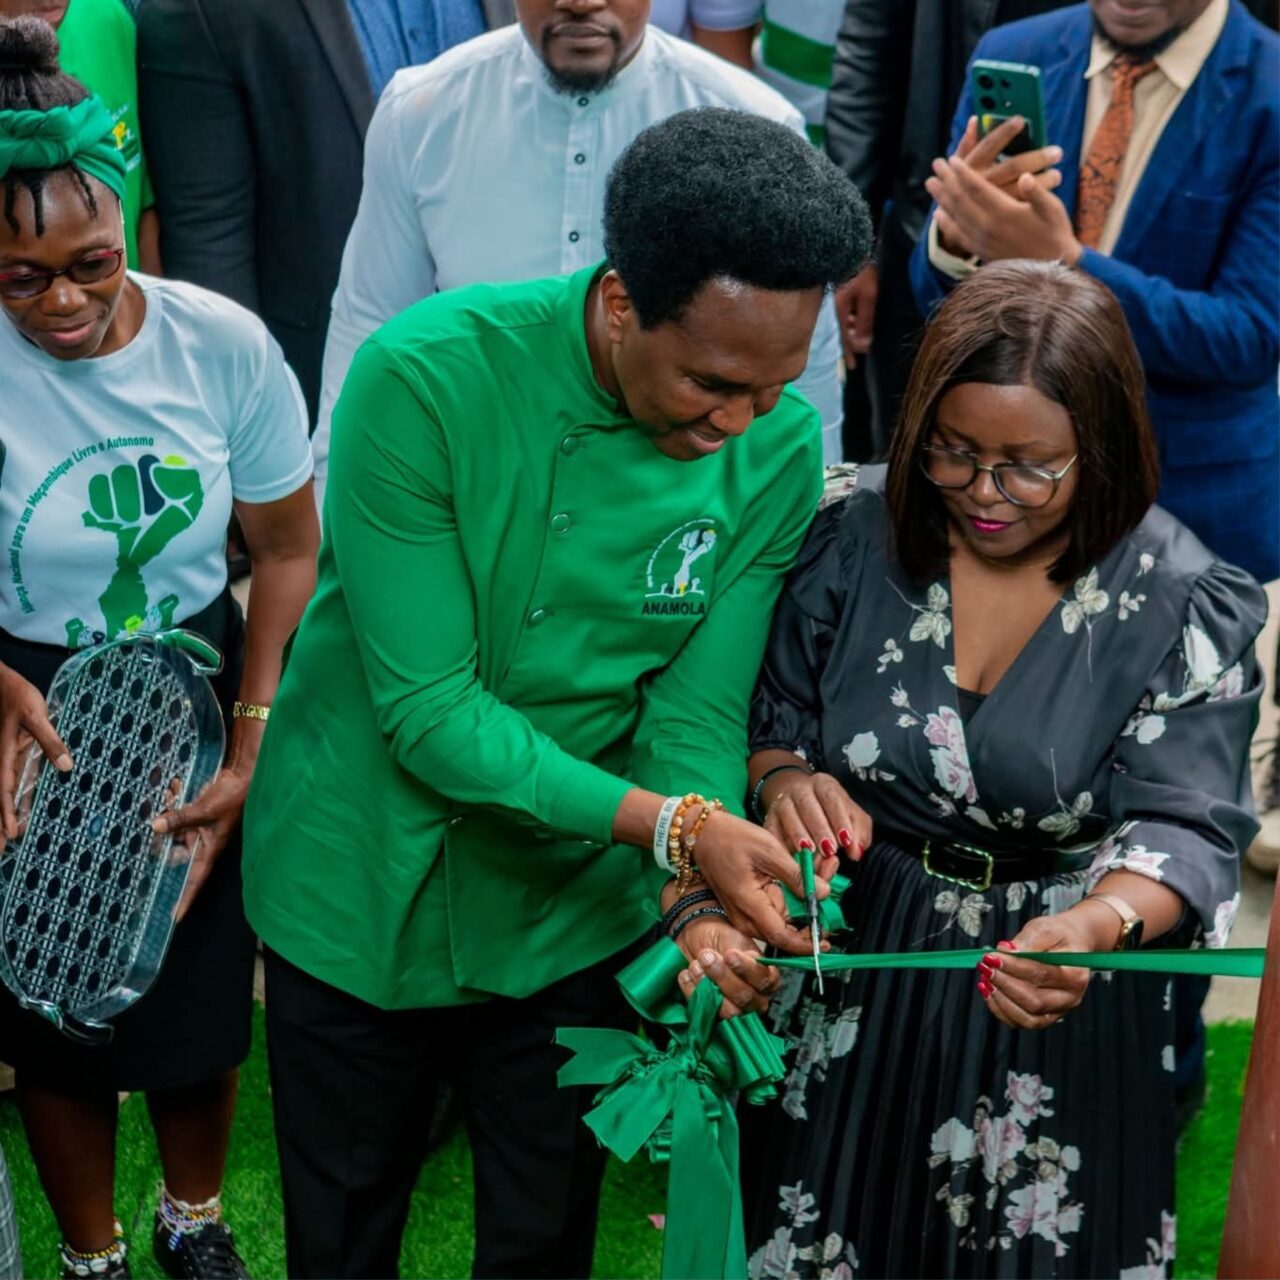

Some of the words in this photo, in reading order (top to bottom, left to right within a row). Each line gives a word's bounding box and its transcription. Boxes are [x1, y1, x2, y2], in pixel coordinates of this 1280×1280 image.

[72, 444, 97, 462] Livre
[98, 442, 105, 451] e
[26, 458, 74, 508] Moçambique
[21, 507, 34, 524] um
[12, 524, 26, 549] para
[641, 602, 705, 615] ANAMOLA
[655, 814, 669, 848] THERE
